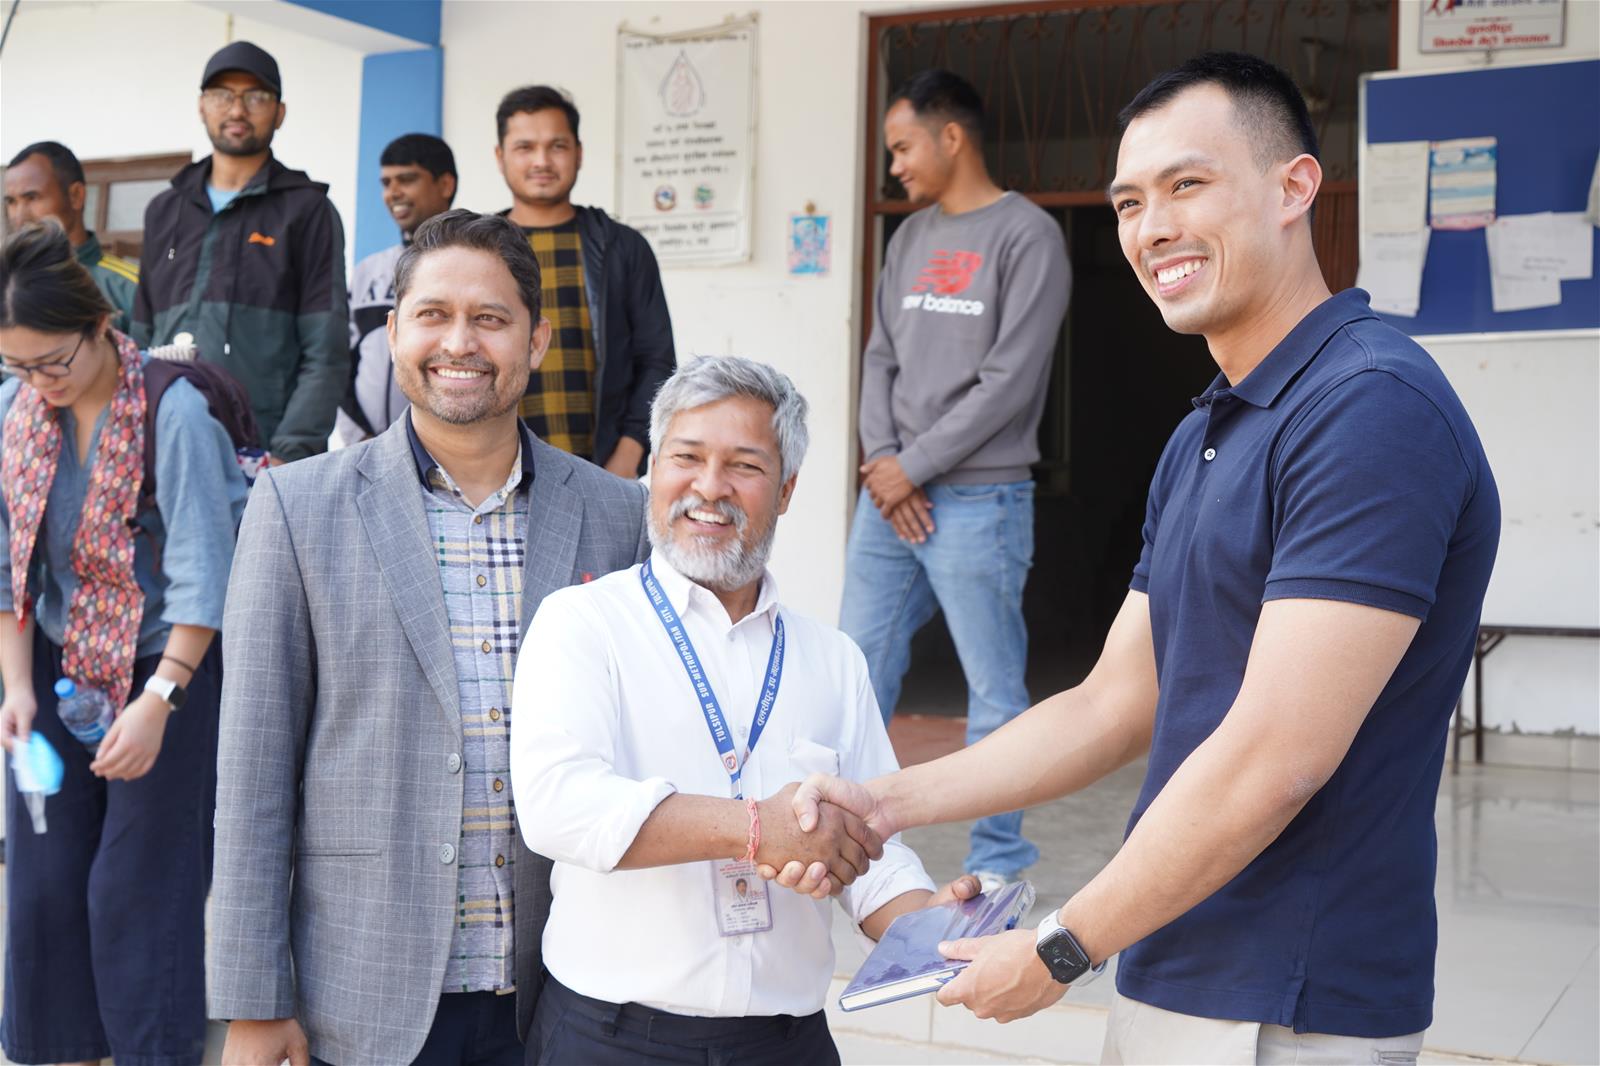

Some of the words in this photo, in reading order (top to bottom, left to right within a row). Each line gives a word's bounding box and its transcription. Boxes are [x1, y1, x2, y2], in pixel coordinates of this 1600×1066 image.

[922, 293, 984, 316] balance
[670, 625, 710, 698] SUB-METROPOLITAN
[705, 702, 727, 743] TULSIPUR
[756, 688, 775, 727] तुलसीपुर
